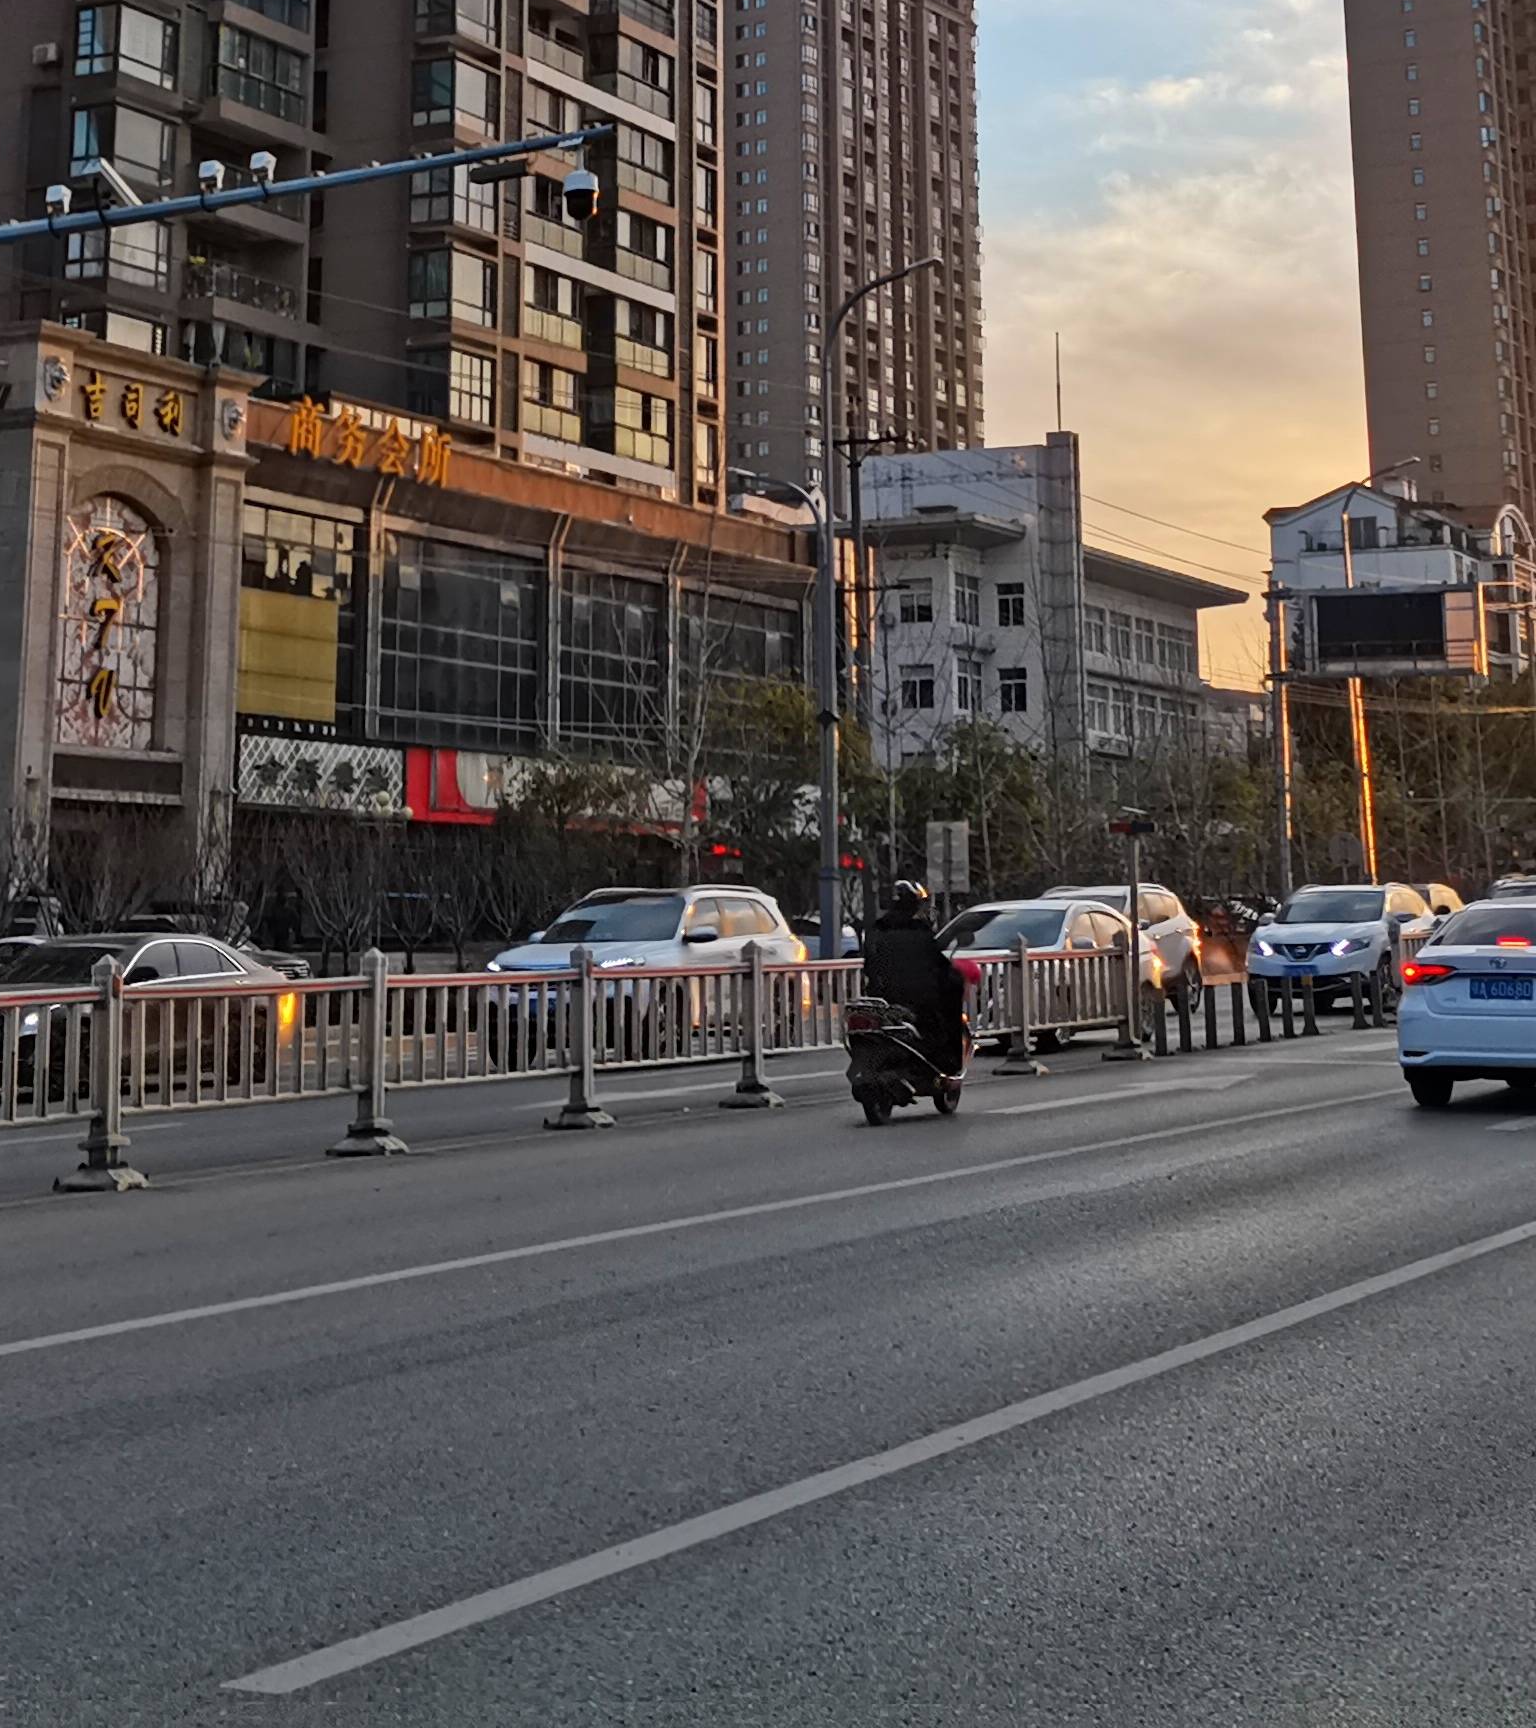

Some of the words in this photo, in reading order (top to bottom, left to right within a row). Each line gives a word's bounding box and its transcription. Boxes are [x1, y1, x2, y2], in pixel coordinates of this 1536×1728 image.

[80, 370, 185, 437] 吉司利
[289, 393, 453, 489] 商务会所
